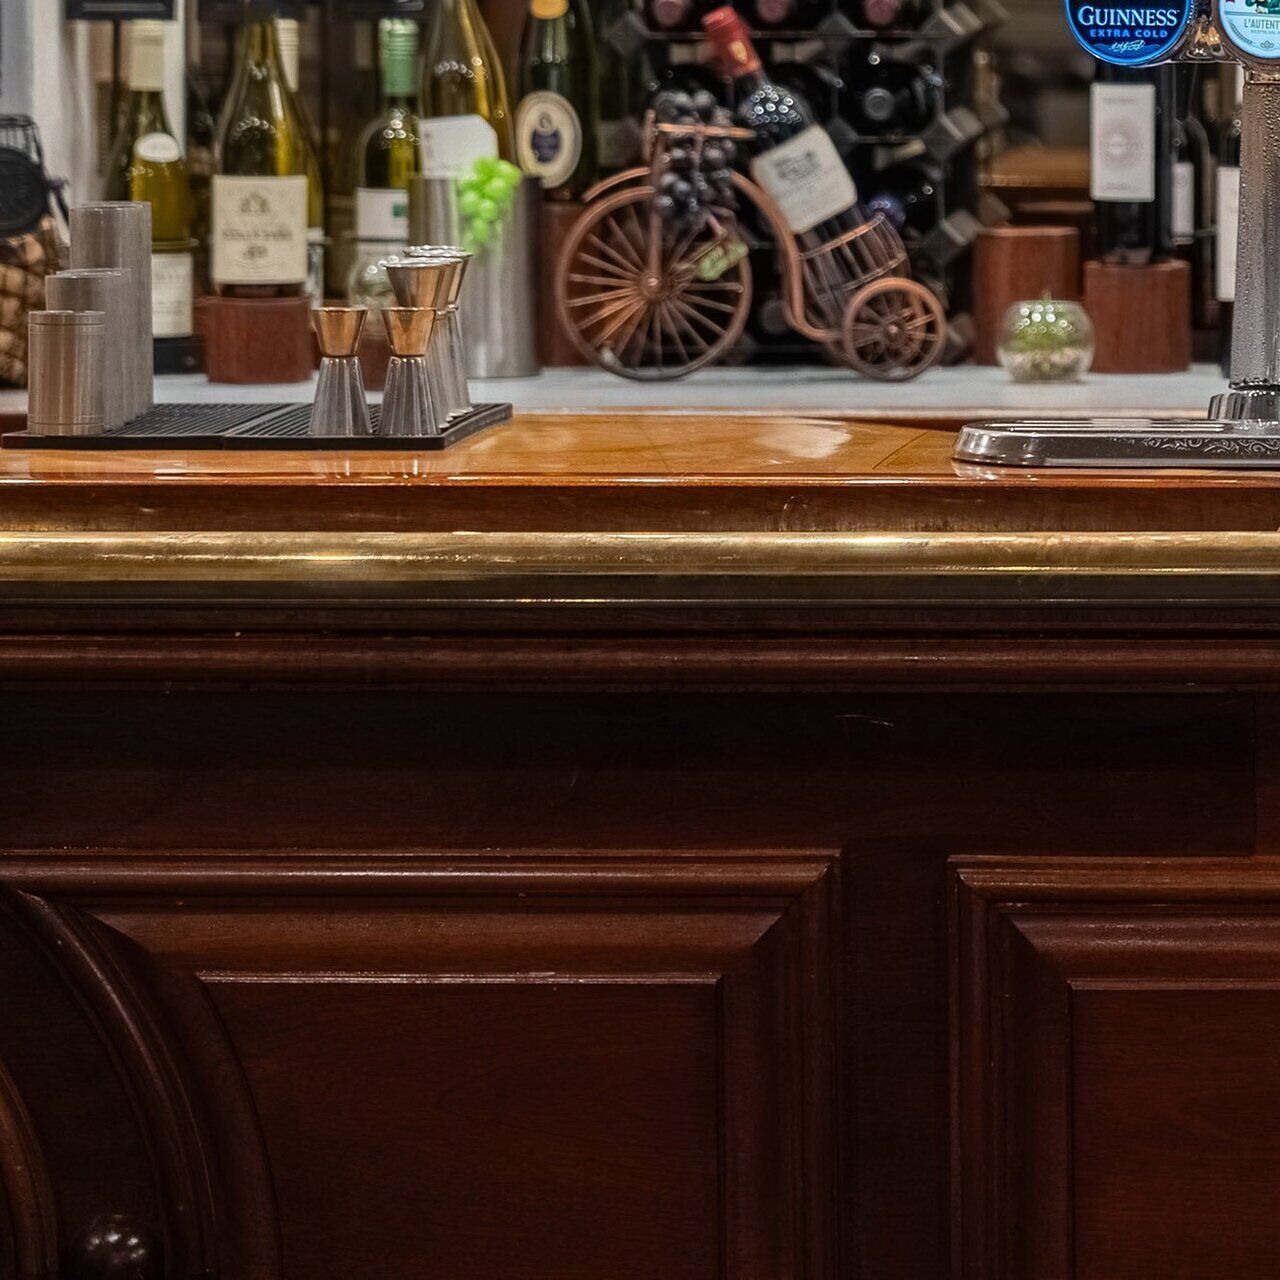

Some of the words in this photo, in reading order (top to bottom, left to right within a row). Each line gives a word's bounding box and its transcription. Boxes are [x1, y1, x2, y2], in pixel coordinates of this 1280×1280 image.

[1078, 5, 1178, 27] GUINNESS
[1089, 28, 1131, 39] EXTRA
[1134, 28, 1169, 39] COLD
